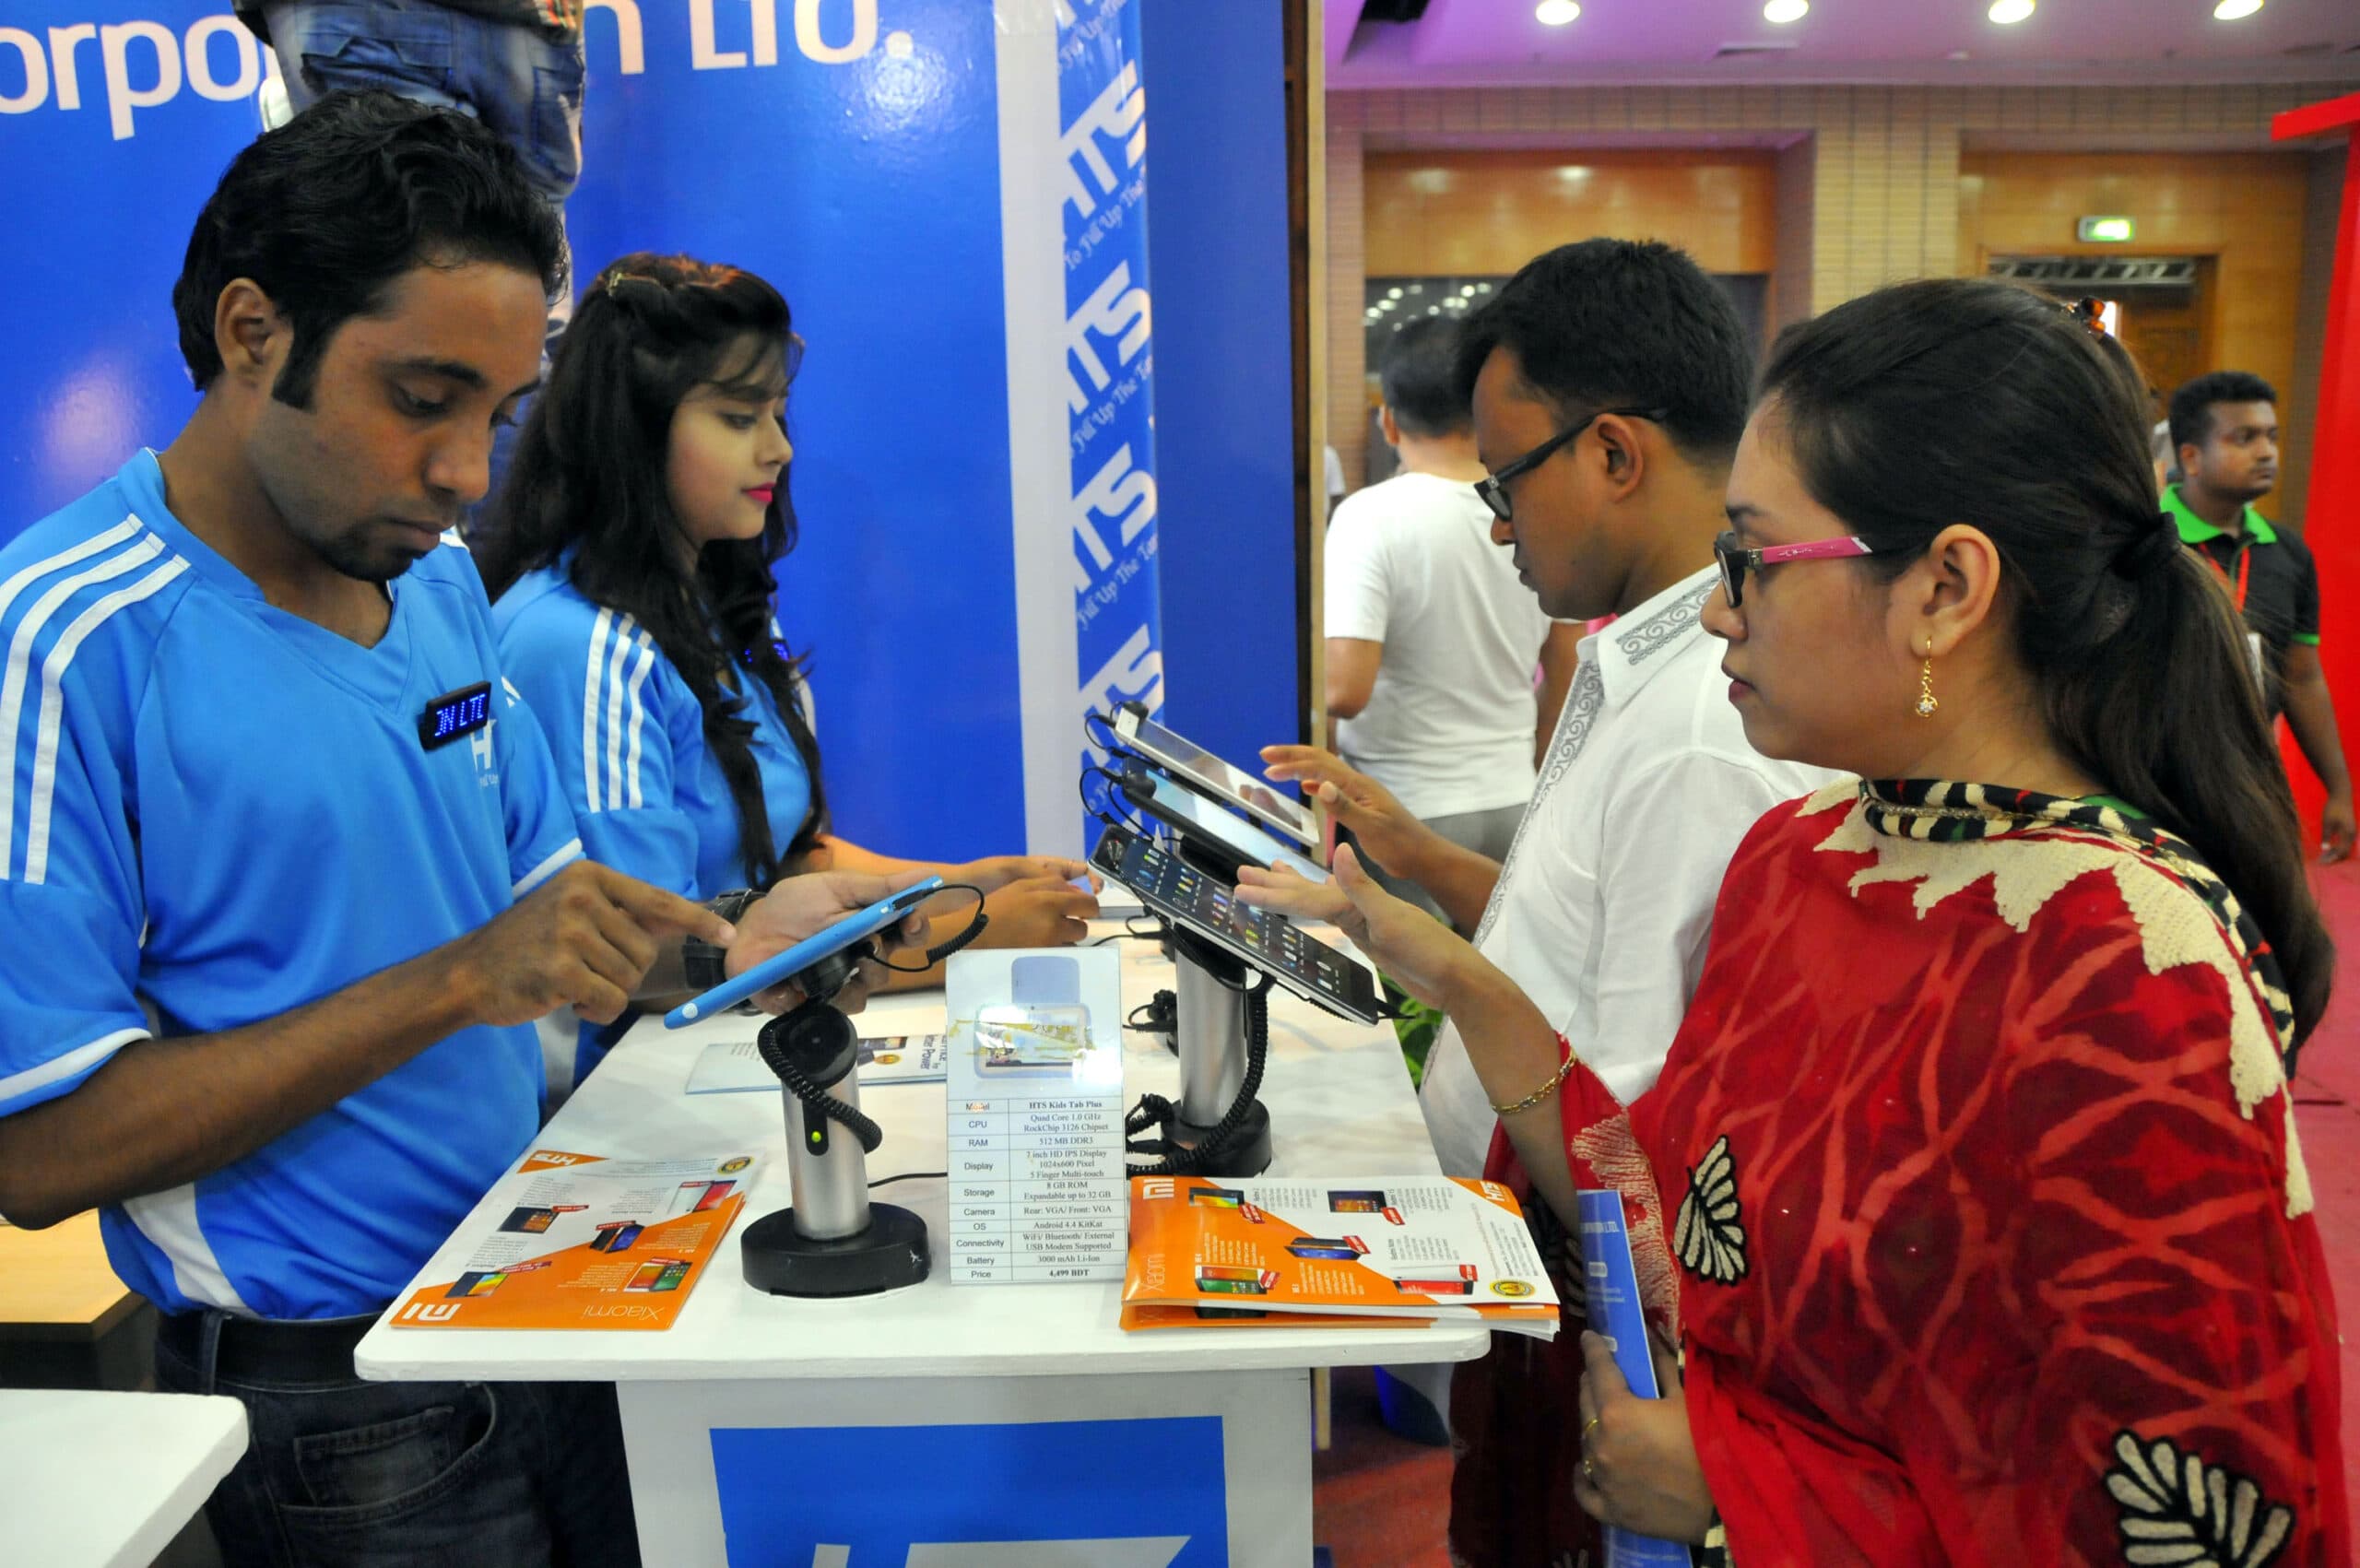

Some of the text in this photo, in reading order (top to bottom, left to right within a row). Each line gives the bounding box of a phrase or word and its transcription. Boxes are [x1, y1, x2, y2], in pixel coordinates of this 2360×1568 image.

[1092, 402, 1115, 424] Up
[1113, 378, 1138, 404] The
[1095, 581, 1117, 604] Up
[1114, 559, 1139, 584] The
[1023, 1125, 1060, 1133] RockChip
[1080, 1124, 1109, 1133] Chipset
[1080, 1149, 1107, 1158] Display
[964, 1161, 994, 1172] Display
[1036, 1171, 1060, 1180] Finger
[1061, 1170, 1104, 1178] Multi-touch
[963, 1188, 995, 1197] Storage
[1023, 1192, 1067, 1202] Expandable
[1068, 1193, 1077, 1201] up
[973, 1222, 986, 1231] OS
[1084, 1232, 1115, 1240] External
[956, 1239, 1004, 1248] Connectivity
[1026, 1243, 1043, 1251] USB
[1075, 1242, 1112, 1252] Supported
[967, 1256, 995, 1266] Battery
[1077, 1254, 1100, 1262] Li-Ion
[971, 1270, 991, 1279] Price
[1049, 1268, 1090, 1278] 4,499 BDT
[582, 1304, 665, 1321] Xiaomi
